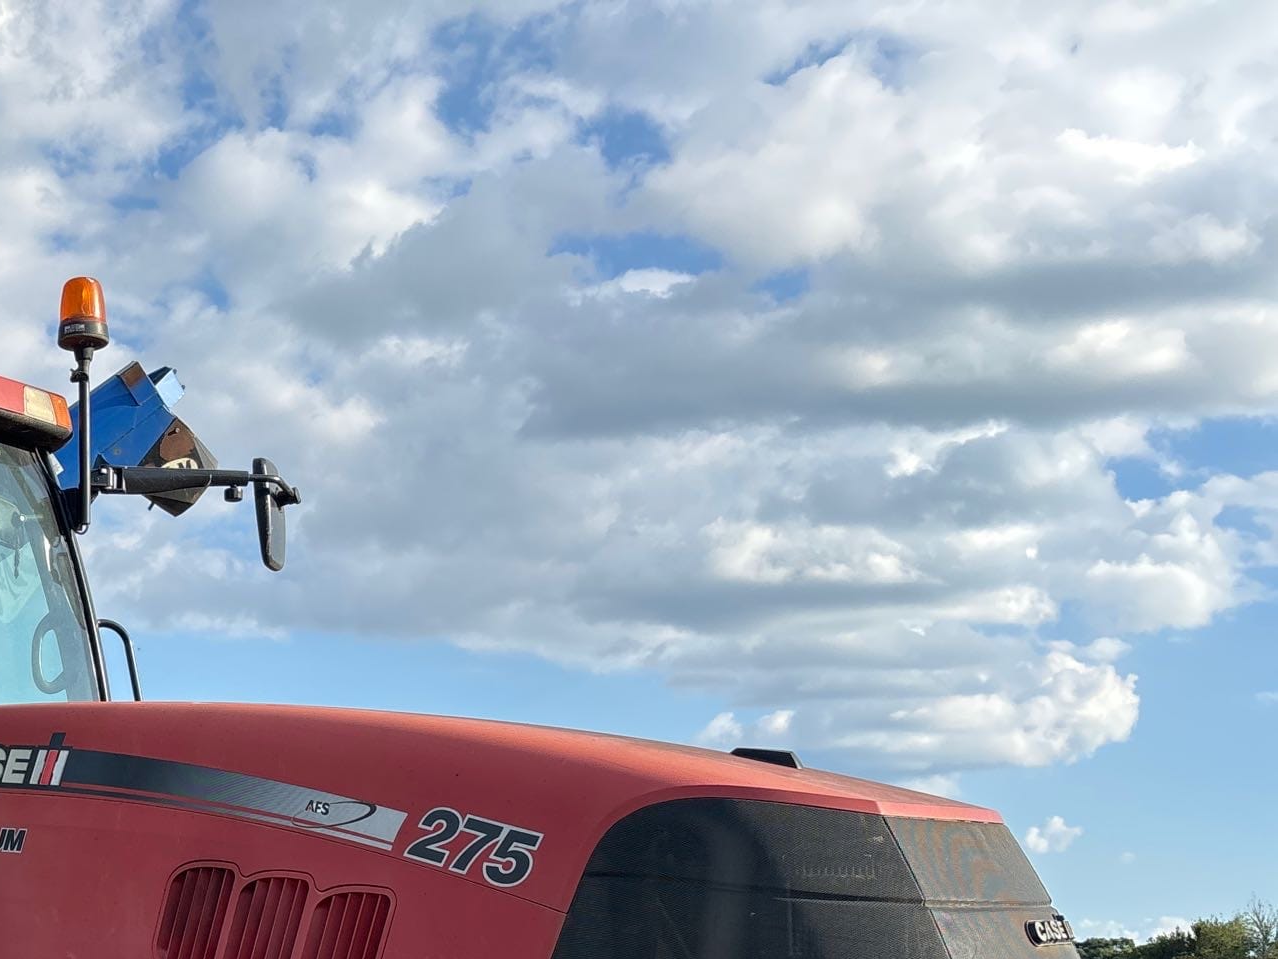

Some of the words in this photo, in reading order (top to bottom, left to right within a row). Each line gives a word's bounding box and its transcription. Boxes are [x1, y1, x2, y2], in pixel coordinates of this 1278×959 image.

[305, 799, 330, 816] AFS
[403, 806, 544, 888] 275
[1034, 920, 1068, 942] CASE
